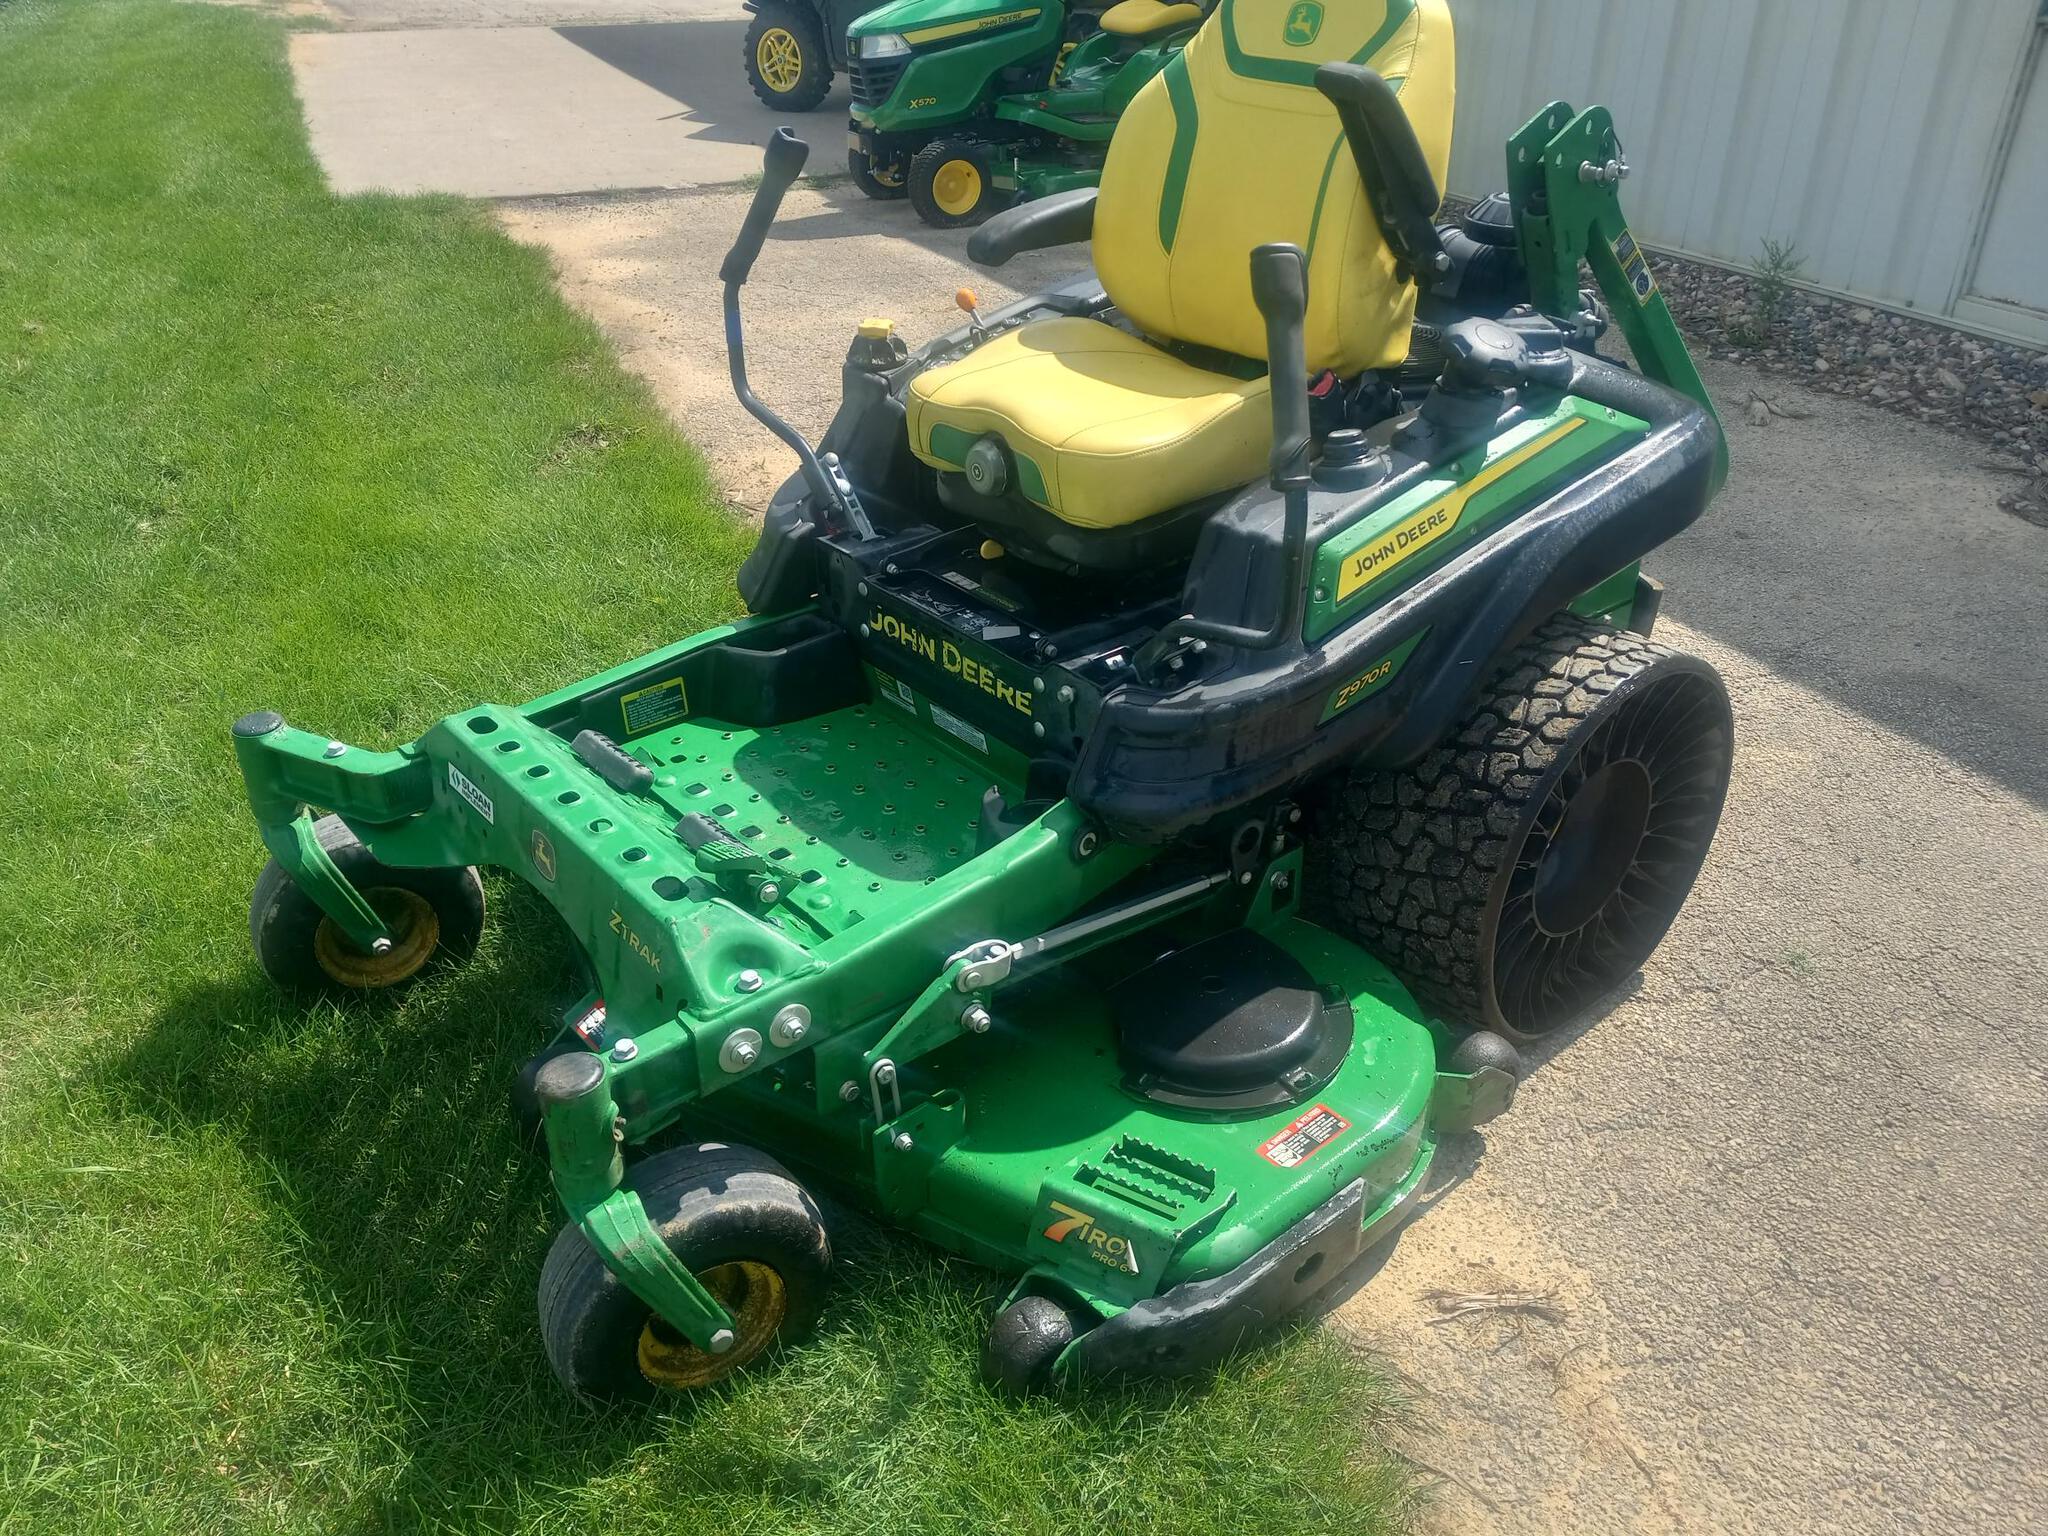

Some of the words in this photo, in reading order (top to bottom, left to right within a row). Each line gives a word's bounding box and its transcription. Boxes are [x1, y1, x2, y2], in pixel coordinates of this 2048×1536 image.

[978, 19, 999, 29] JOHN
[999, 12, 1022, 24] DEERE
[909, 97, 937, 110] X570
[1353, 540, 1396, 578] JOHN
[1396, 508, 1448, 550] DEERE
[869, 605, 936, 662] JOHN
[942, 640, 1032, 716] DEERE
[1334, 660, 1392, 710] Z970R
[461, 777, 491, 812] SLOAN
[609, 908, 660, 974] ZTRAK
[1091, 1250, 1118, 1268] PRO
